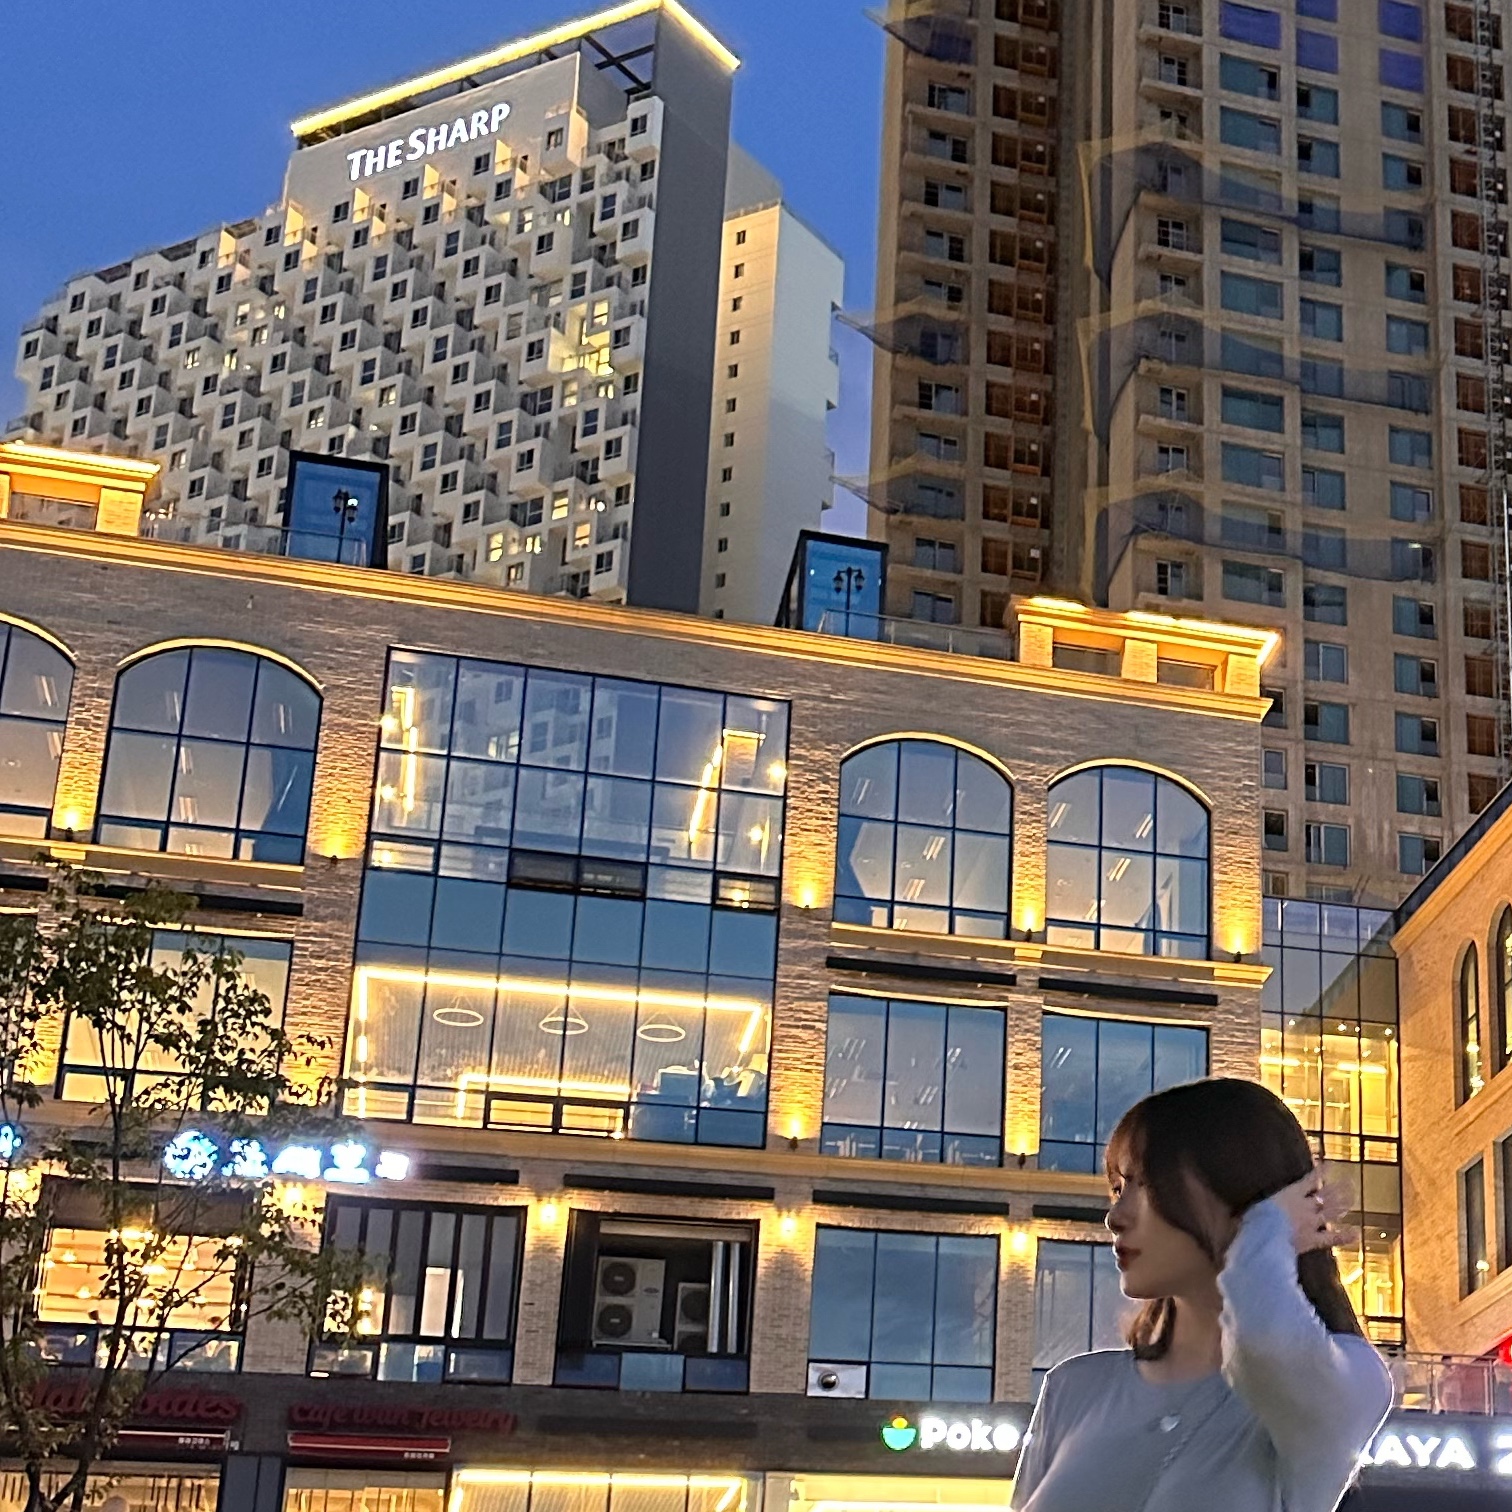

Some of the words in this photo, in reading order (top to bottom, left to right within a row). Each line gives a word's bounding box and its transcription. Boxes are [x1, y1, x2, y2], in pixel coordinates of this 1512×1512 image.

[347, 138, 404, 181] THE
[405, 102, 511, 161] SHARP
[1361, 1434, 1476, 1470] AYA
